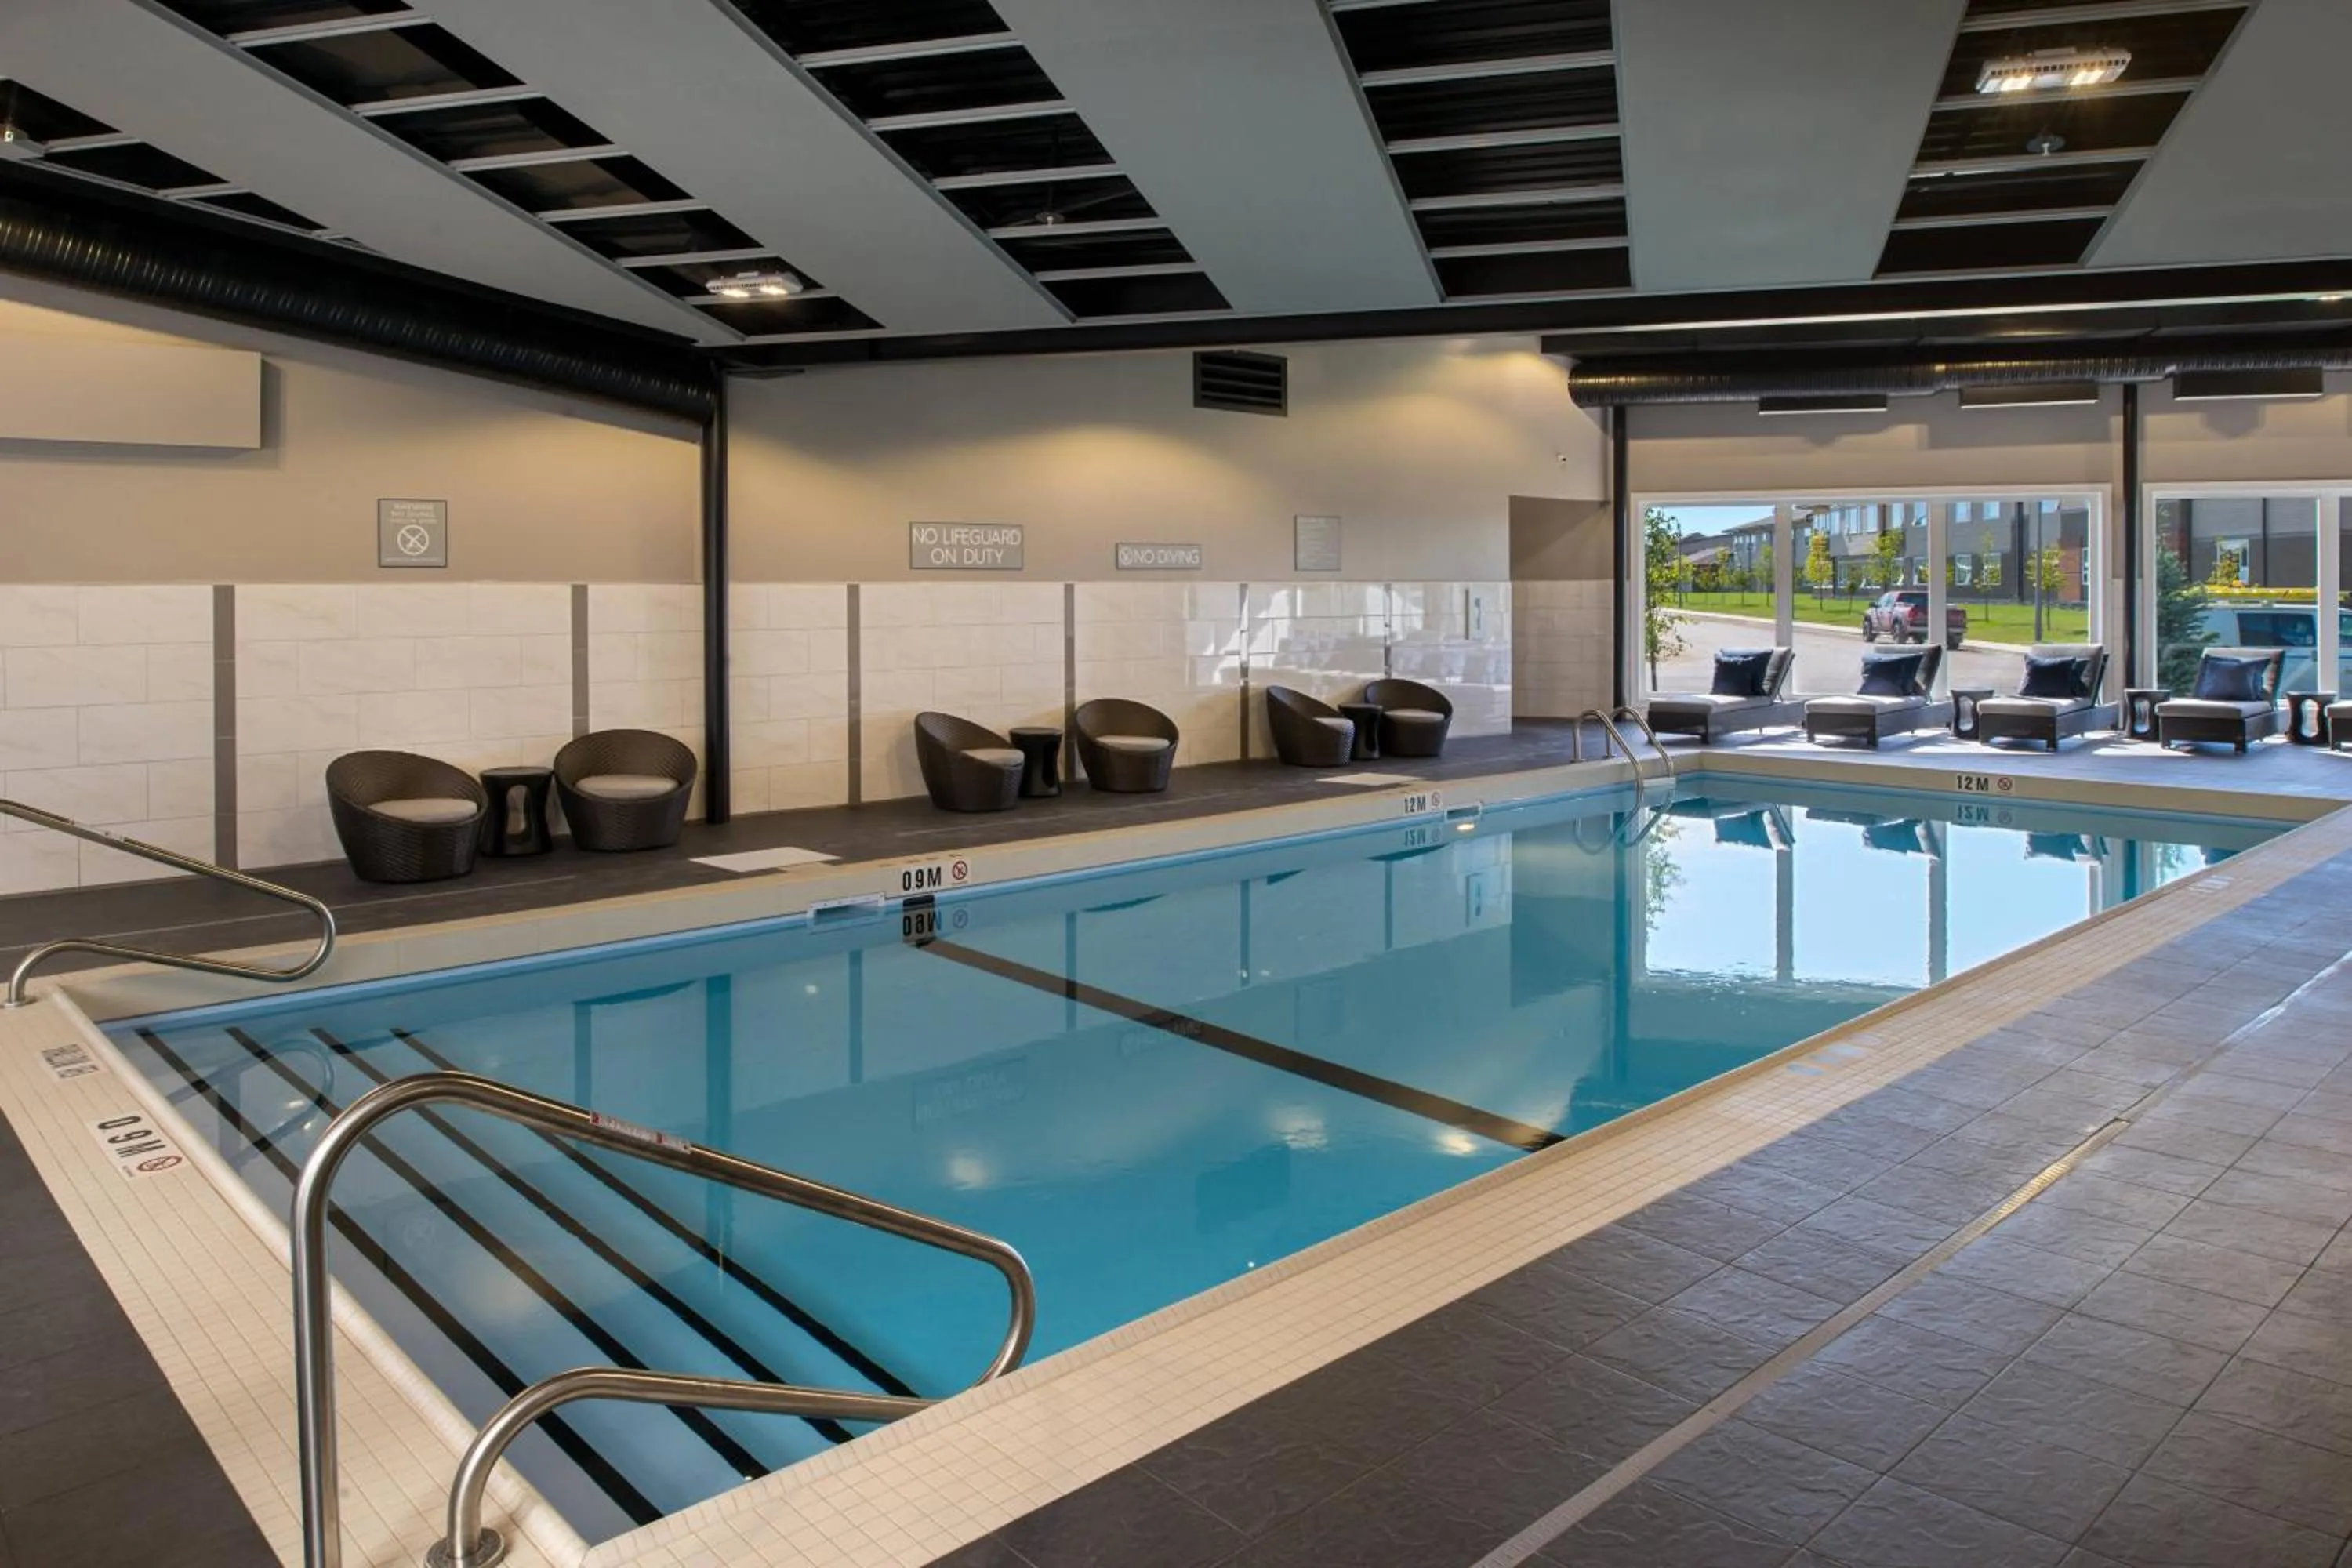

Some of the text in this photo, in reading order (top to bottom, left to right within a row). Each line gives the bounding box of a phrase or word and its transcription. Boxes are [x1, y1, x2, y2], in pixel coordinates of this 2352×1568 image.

[913, 528, 1021, 546] NO LIFEGUARD
[931, 548, 1004, 564] ON DUTY
[1134, 550, 1200, 564] NO DIVING
